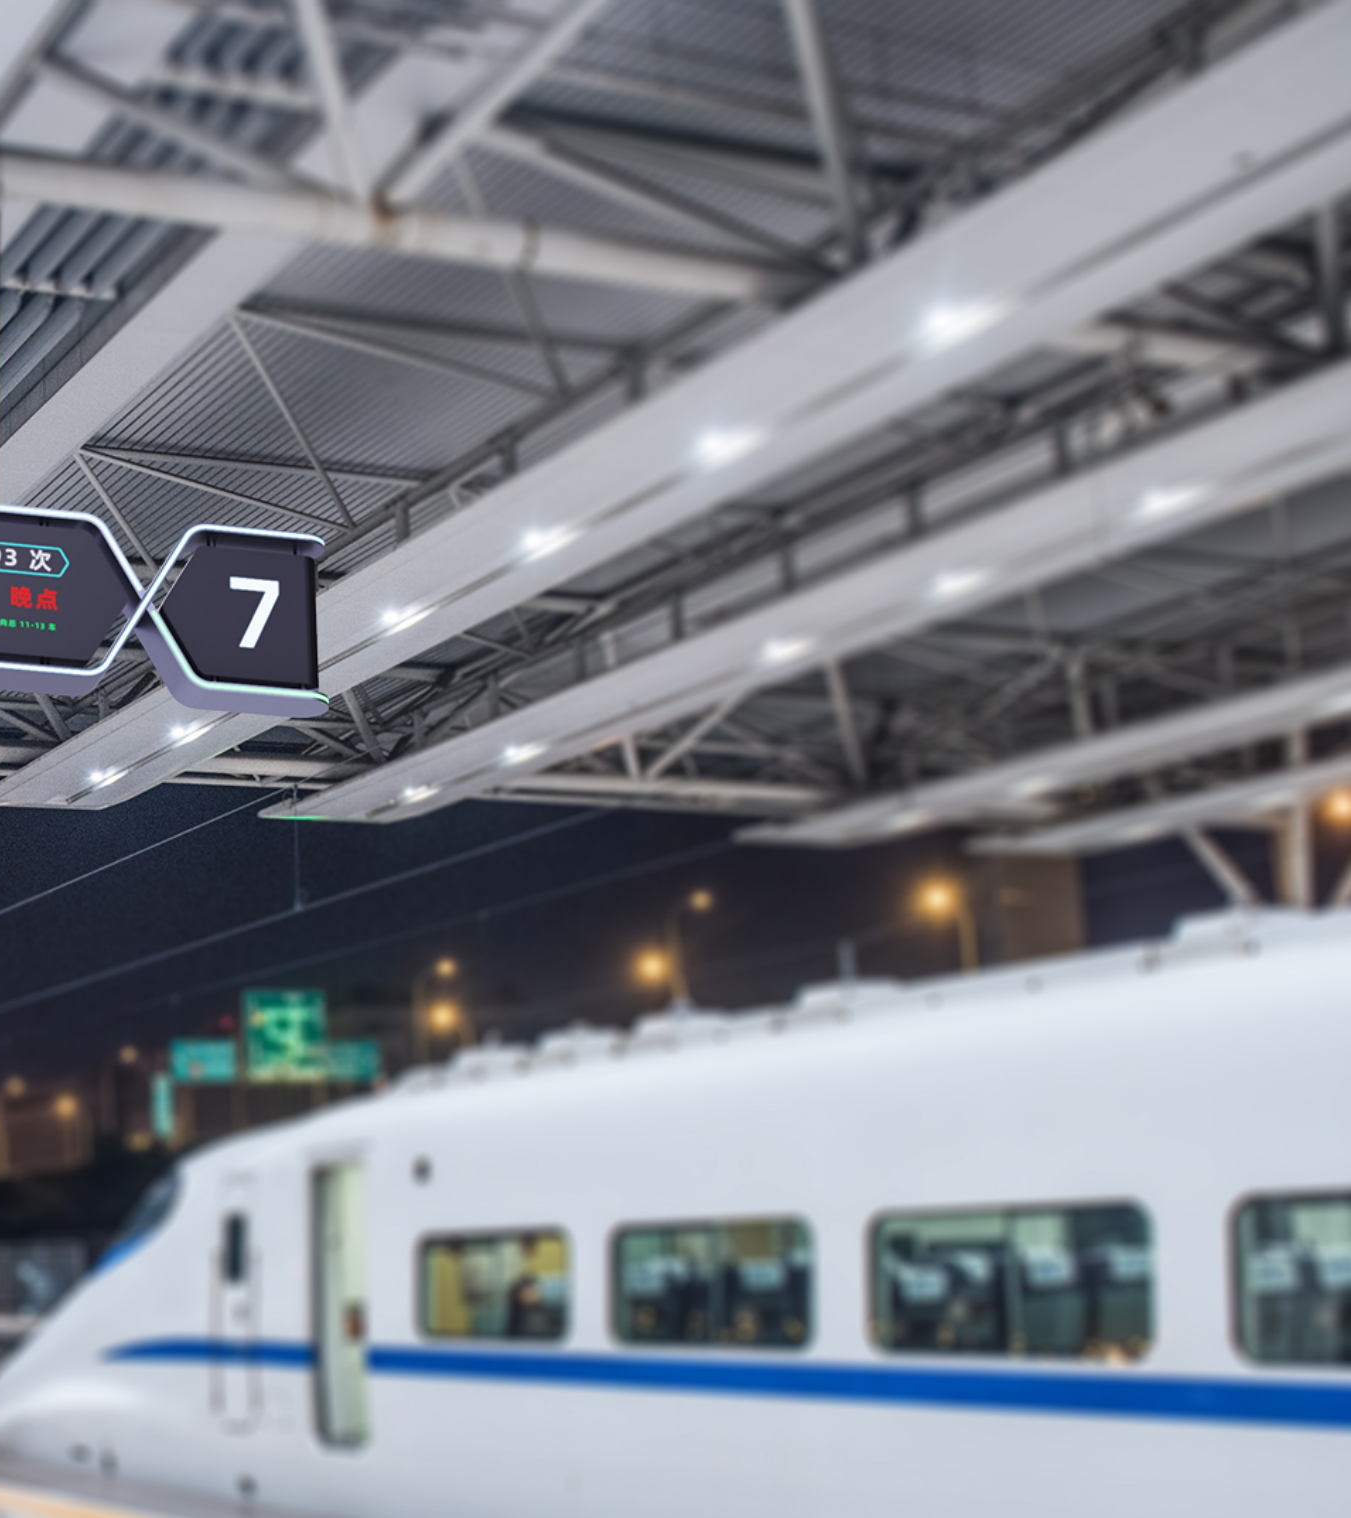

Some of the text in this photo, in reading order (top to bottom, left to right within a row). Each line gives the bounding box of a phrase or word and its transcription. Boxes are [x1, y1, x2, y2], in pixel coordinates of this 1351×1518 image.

[28, 548, 53, 572] 次
[9, 585, 59, 611] 晚点
[228, 576, 281, 649] 7
